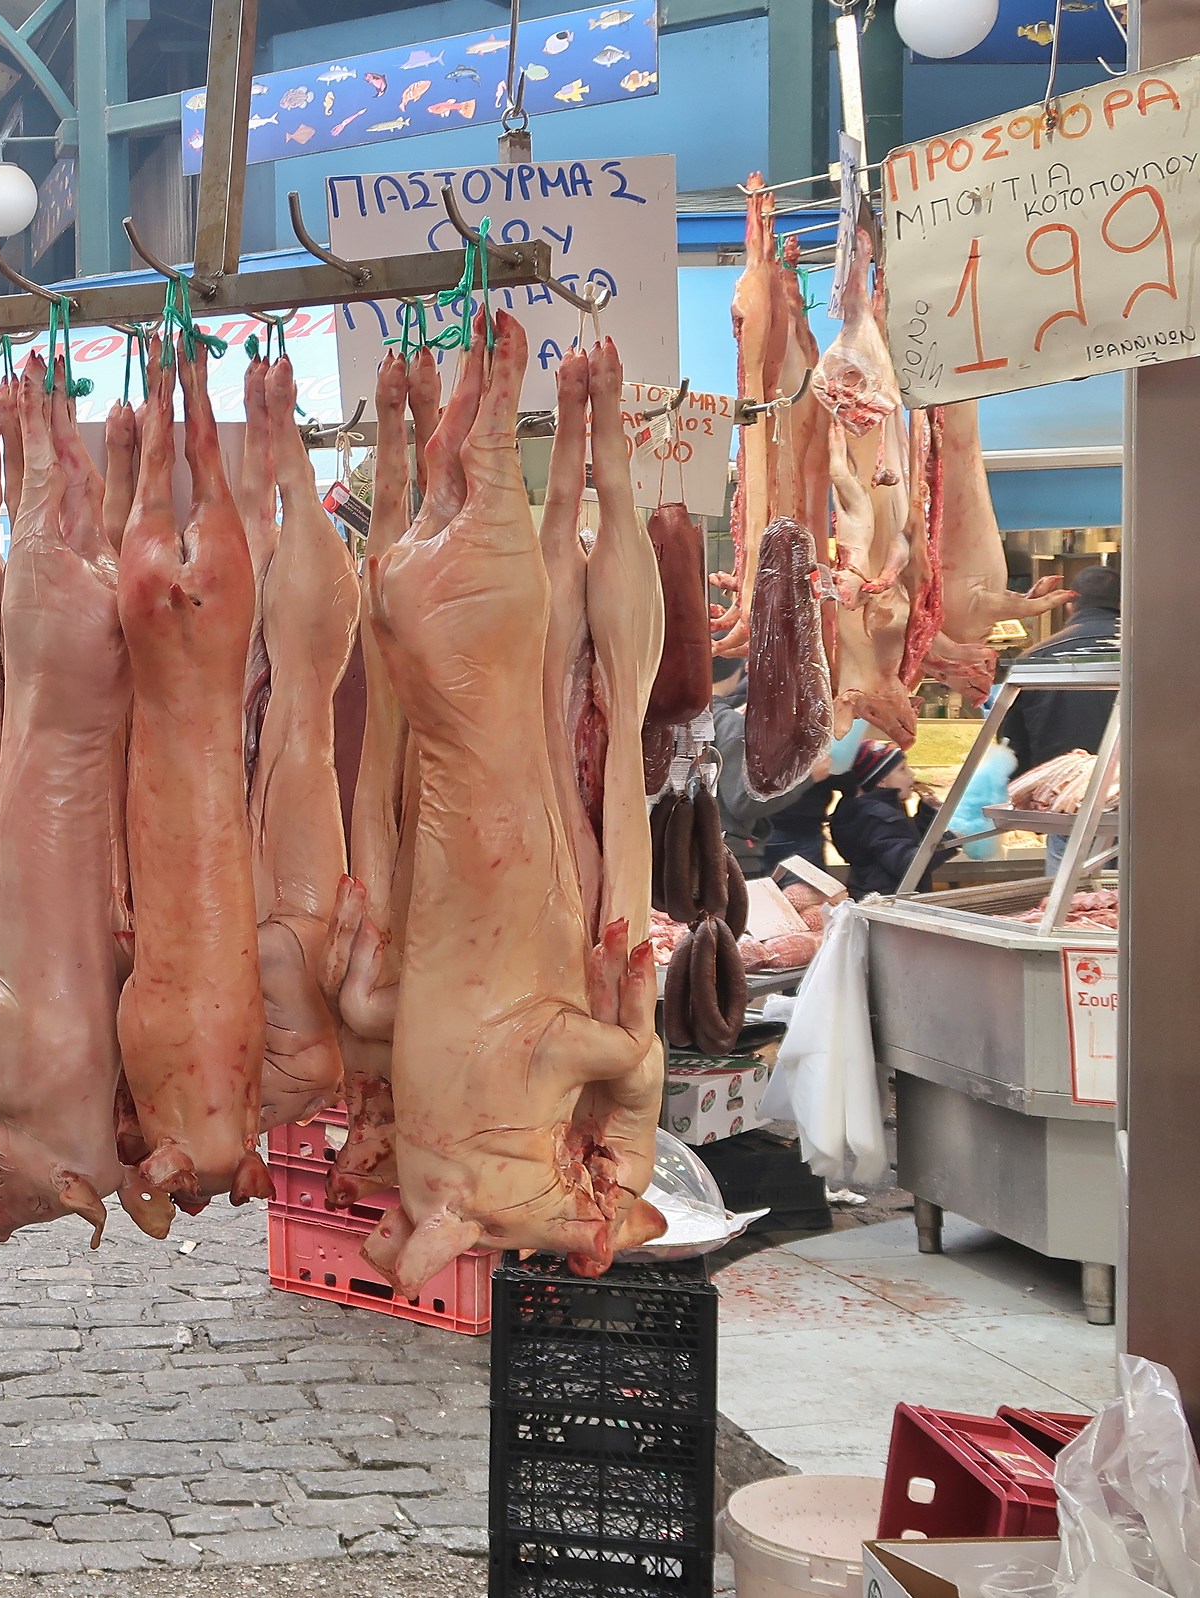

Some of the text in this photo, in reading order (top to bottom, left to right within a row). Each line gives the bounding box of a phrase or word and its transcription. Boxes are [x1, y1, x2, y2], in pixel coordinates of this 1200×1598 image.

[886, 78, 1180, 201] ΠΡΟΣΦΟΡΑ
[328, 161, 647, 218] ΠΑΣΤΟΥΡΜΑΣ
[896, 163, 1071, 240] ΜΠΟΥΤΙΑ
